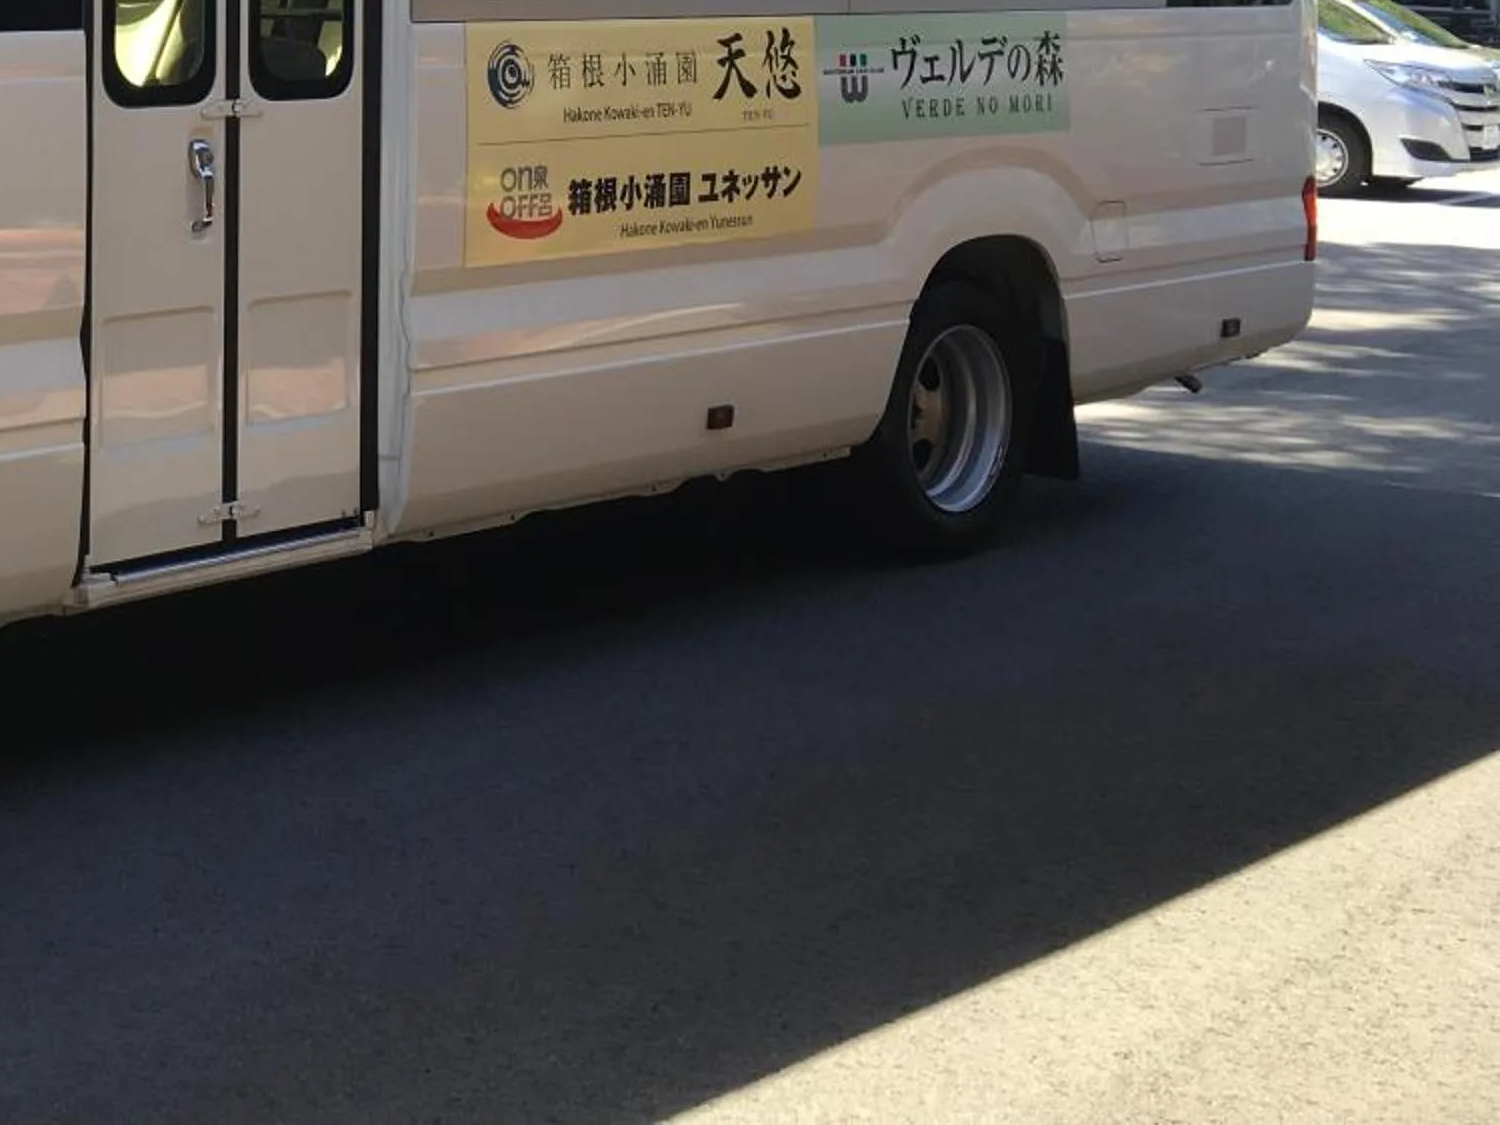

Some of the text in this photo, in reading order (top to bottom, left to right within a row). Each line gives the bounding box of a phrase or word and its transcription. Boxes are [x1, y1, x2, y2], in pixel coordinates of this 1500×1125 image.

[547, 27, 802, 100] 箱根小涌園 天悠
[890, 30, 1064, 90] ヴェルデの森
[563, 106, 603, 124] Hakone
[604, 104, 655, 123] Kowaki-en
[901, 92, 1052, 119] VERDE NO MORI
[567, 165, 803, 217] 箱根小涌園 ユネッサン
[619, 222, 657, 240] Hakone
